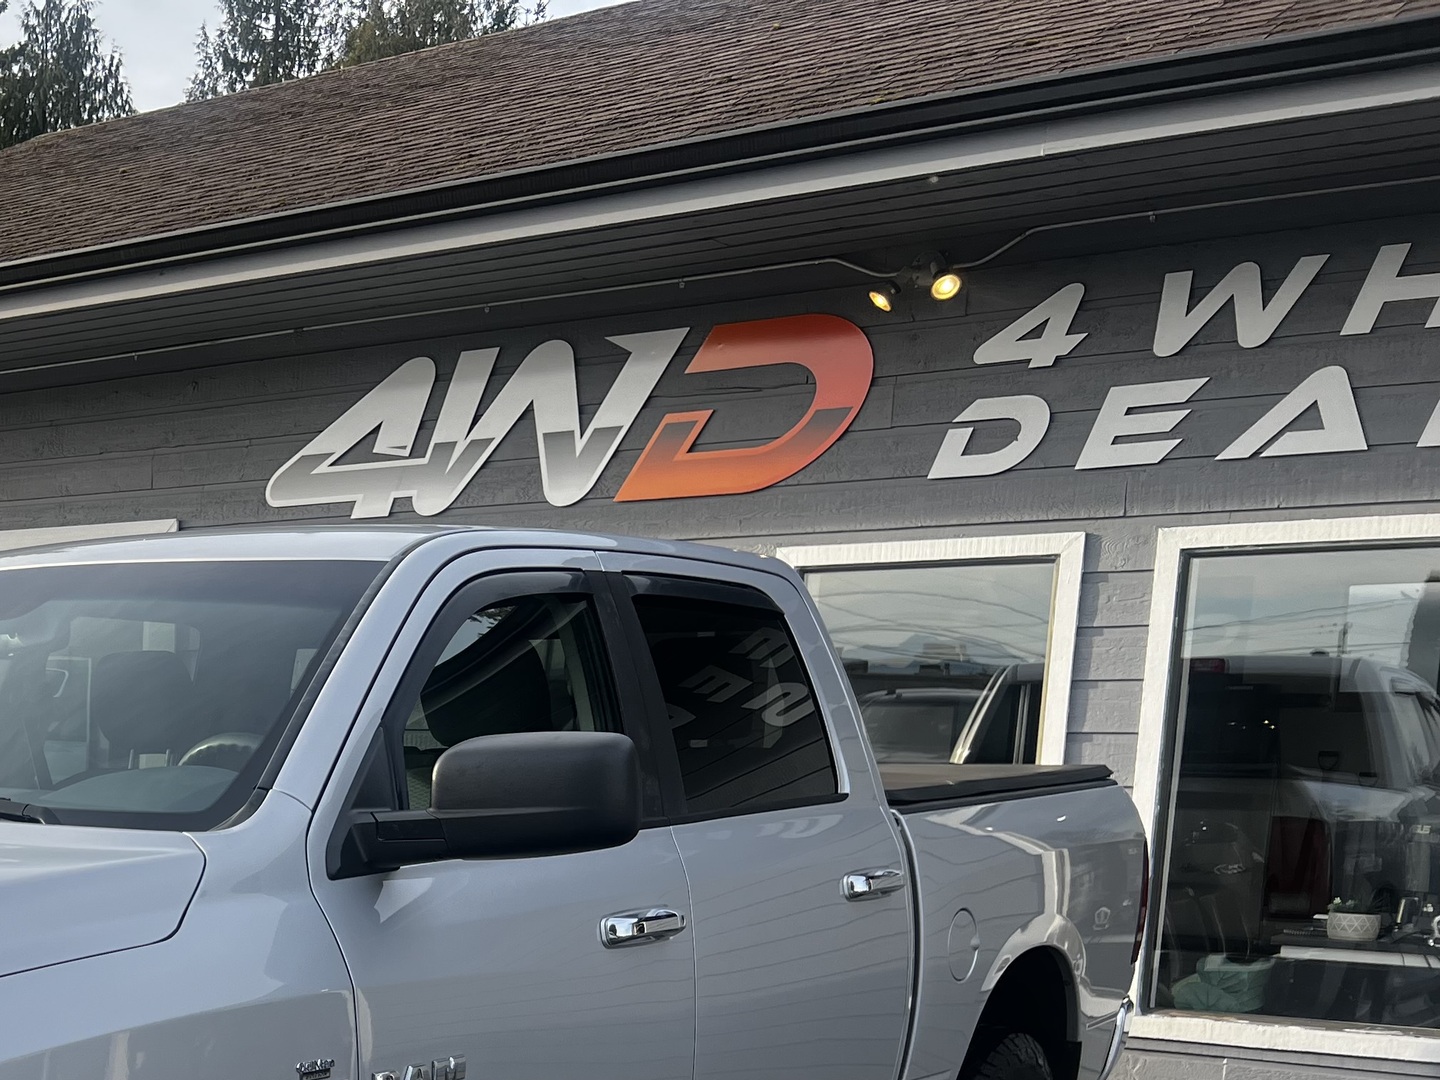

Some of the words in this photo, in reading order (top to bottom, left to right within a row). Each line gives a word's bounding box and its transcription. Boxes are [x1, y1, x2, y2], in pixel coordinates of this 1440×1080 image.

[973, 282, 1089, 369] 4
[265, 312, 875, 519] 4WD
[927, 364, 1440, 480] DEA
